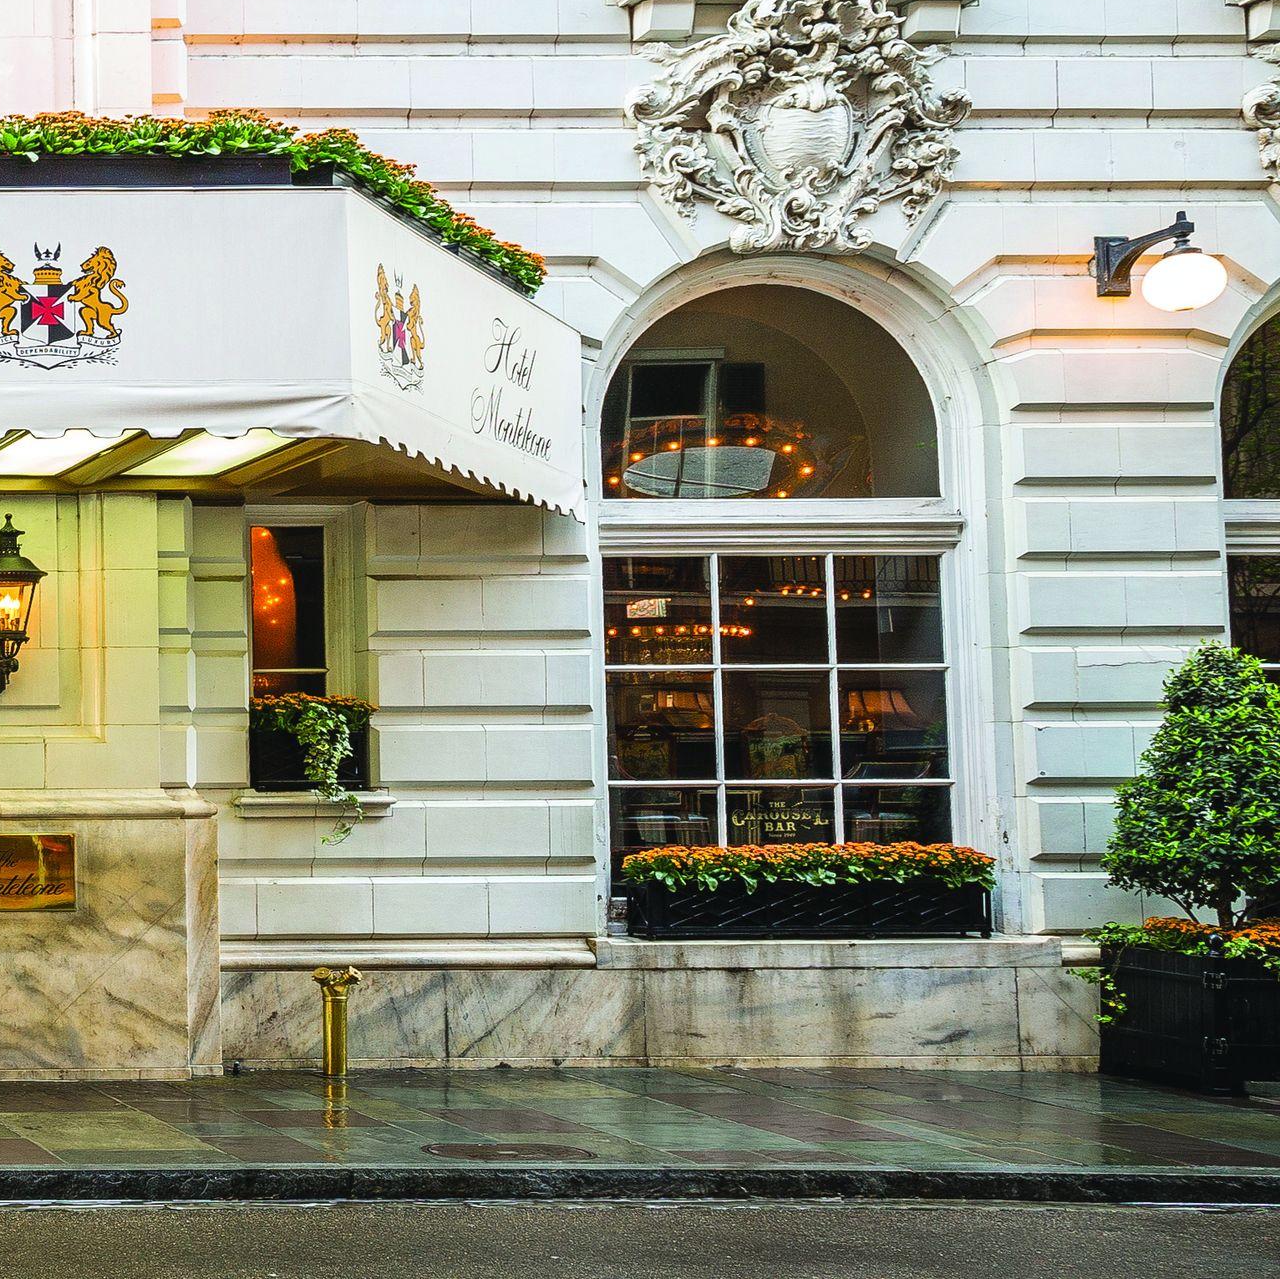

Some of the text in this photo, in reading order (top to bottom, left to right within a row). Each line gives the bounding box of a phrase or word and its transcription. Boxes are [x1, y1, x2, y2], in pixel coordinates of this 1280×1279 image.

[82, 336, 117, 346] LUXURY
[20, 347, 77, 356] DEPENDABILITY
[484, 317, 537, 392] Hotel
[470, 384, 552, 462] Monteleone
[731, 808, 829, 826] CAROUSEL
[765, 821, 797, 832] BAR
